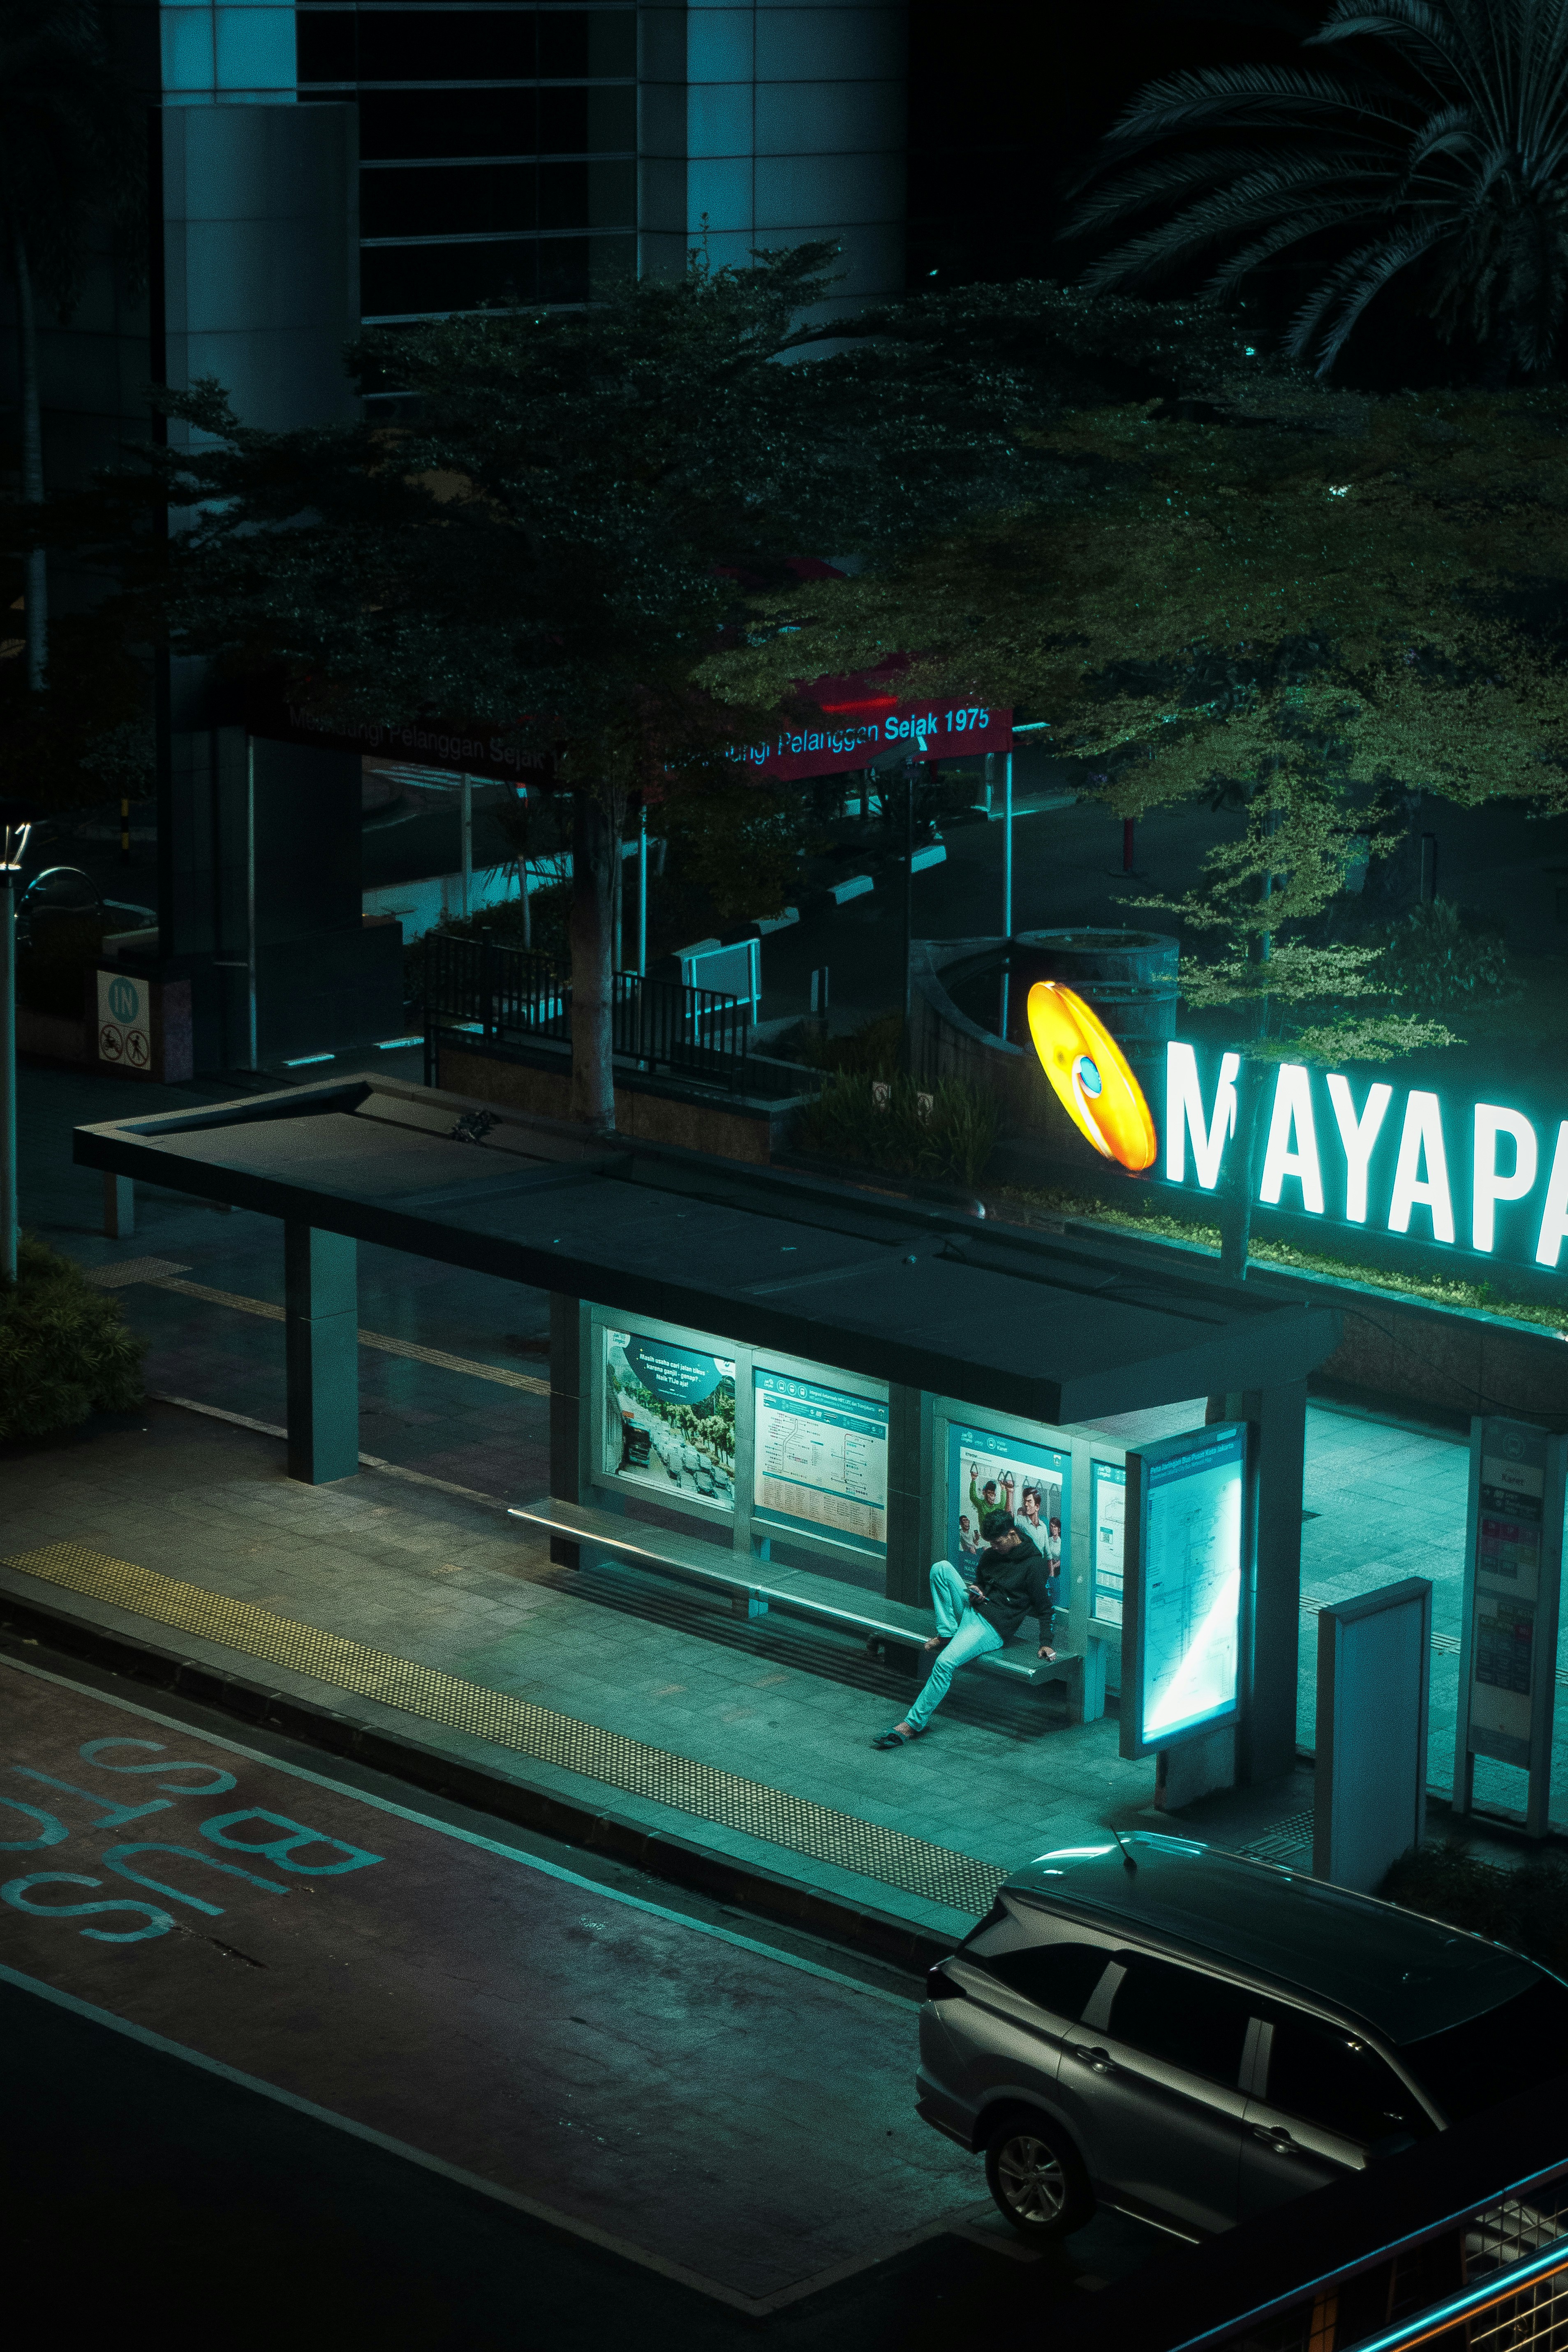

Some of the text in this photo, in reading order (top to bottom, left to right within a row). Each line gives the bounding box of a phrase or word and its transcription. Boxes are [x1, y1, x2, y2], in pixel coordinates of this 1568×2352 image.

[778, 708, 990, 756] Pelanggan Sejak 1975
[389, 724, 485, 761] Pelanggan
[489, 736, 546, 772] Sejak
[114, 985, 133, 1016] IN
[639, 1353, 654, 1362] Masih
[655, 1358, 670, 1367] usaha
[680, 1363, 692, 1372] jalan
[693, 1367, 705, 1376] tikus
[647, 1363, 663, 1373] karena
[664, 1368, 677, 1377] ganjil
[680, 1373, 698, 1382] genap?
[656, 1374, 668, 1382] Naik
[1502, 1473, 1524, 1486] Karet
[0, 1806, 385, 1943] BUS
